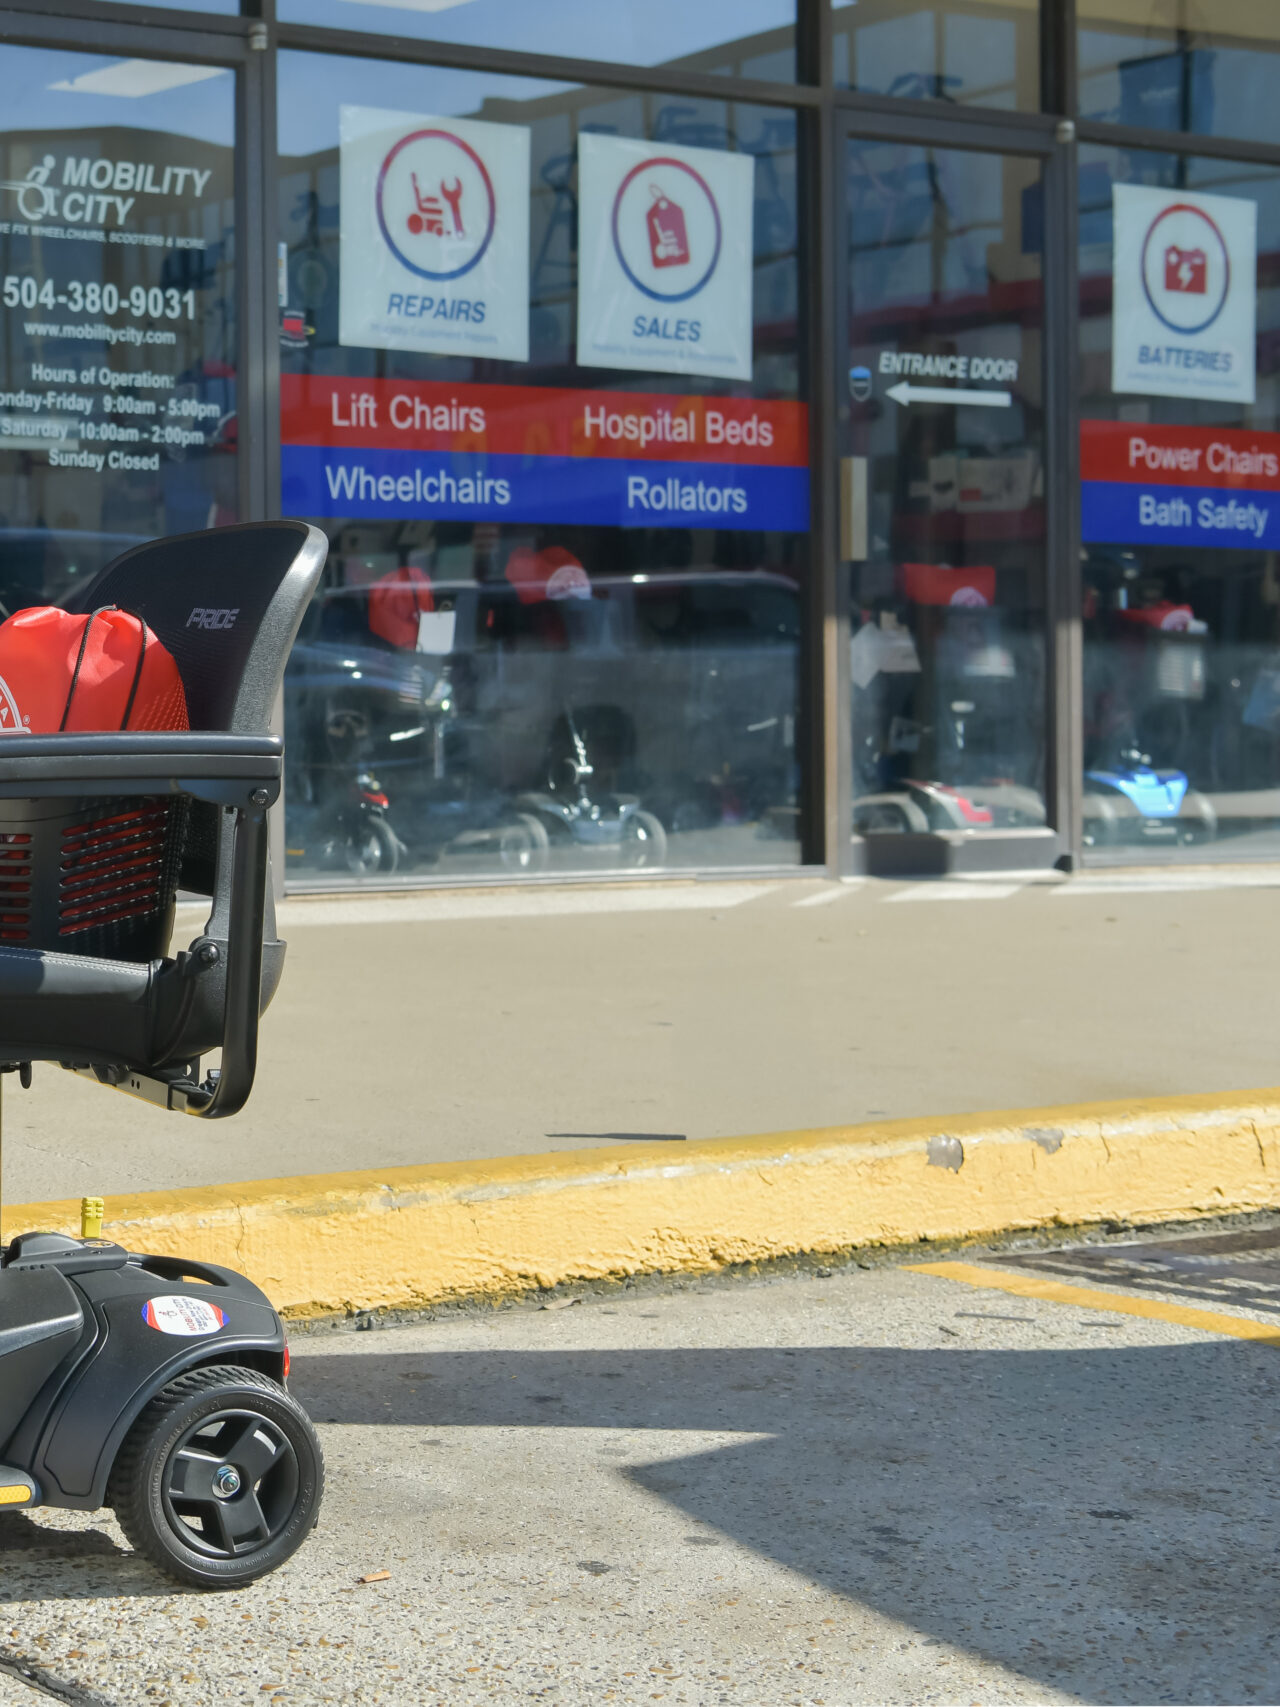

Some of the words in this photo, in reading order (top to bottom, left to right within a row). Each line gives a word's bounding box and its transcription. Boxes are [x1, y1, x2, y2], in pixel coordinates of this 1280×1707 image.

[63, 157, 211, 197] MOBILITY
[63, 192, 135, 225] CITY
[3, 276, 195, 320] 504-380-9031
[387, 293, 486, 324] REPAIRS
[24, 322, 176, 346] www.mobilitycity.com
[632, 315, 701, 342] SALES
[879, 351, 967, 379] ENTRANCE
[970, 356, 1018, 380] DOOR
[1138, 345, 1233, 373] BATTERIES
[31, 363, 77, 384] Hours
[80, 367, 96, 385] of
[99, 368, 175, 389] Operation:
[103, 395, 156, 414] 9:00am
[168, 400, 220, 421] 5:00pm
[331, 392, 377, 428] Lift
[389, 395, 486, 433] Chairs
[1, 418, 69, 441] Saturday
[78, 422, 139, 442] 10:00am
[151, 426, 205, 447] 2:00pm
[584, 405, 696, 448] Hospital
[705, 411, 774, 446] Beds
[49, 450, 105, 472] Sunday
[108, 451, 159, 470] Closed
[1129, 437, 1202, 472] Power
[1206, 442, 1279, 476] Chairs
[325, 464, 510, 505] Wheelchairs
[627, 476, 748, 512] Rollators
[1139, 495, 1192, 527] Bath
[1197, 498, 1269, 537] Safety
[186, 607, 240, 630] PRIDE
[0, 706, 9, 722] A
